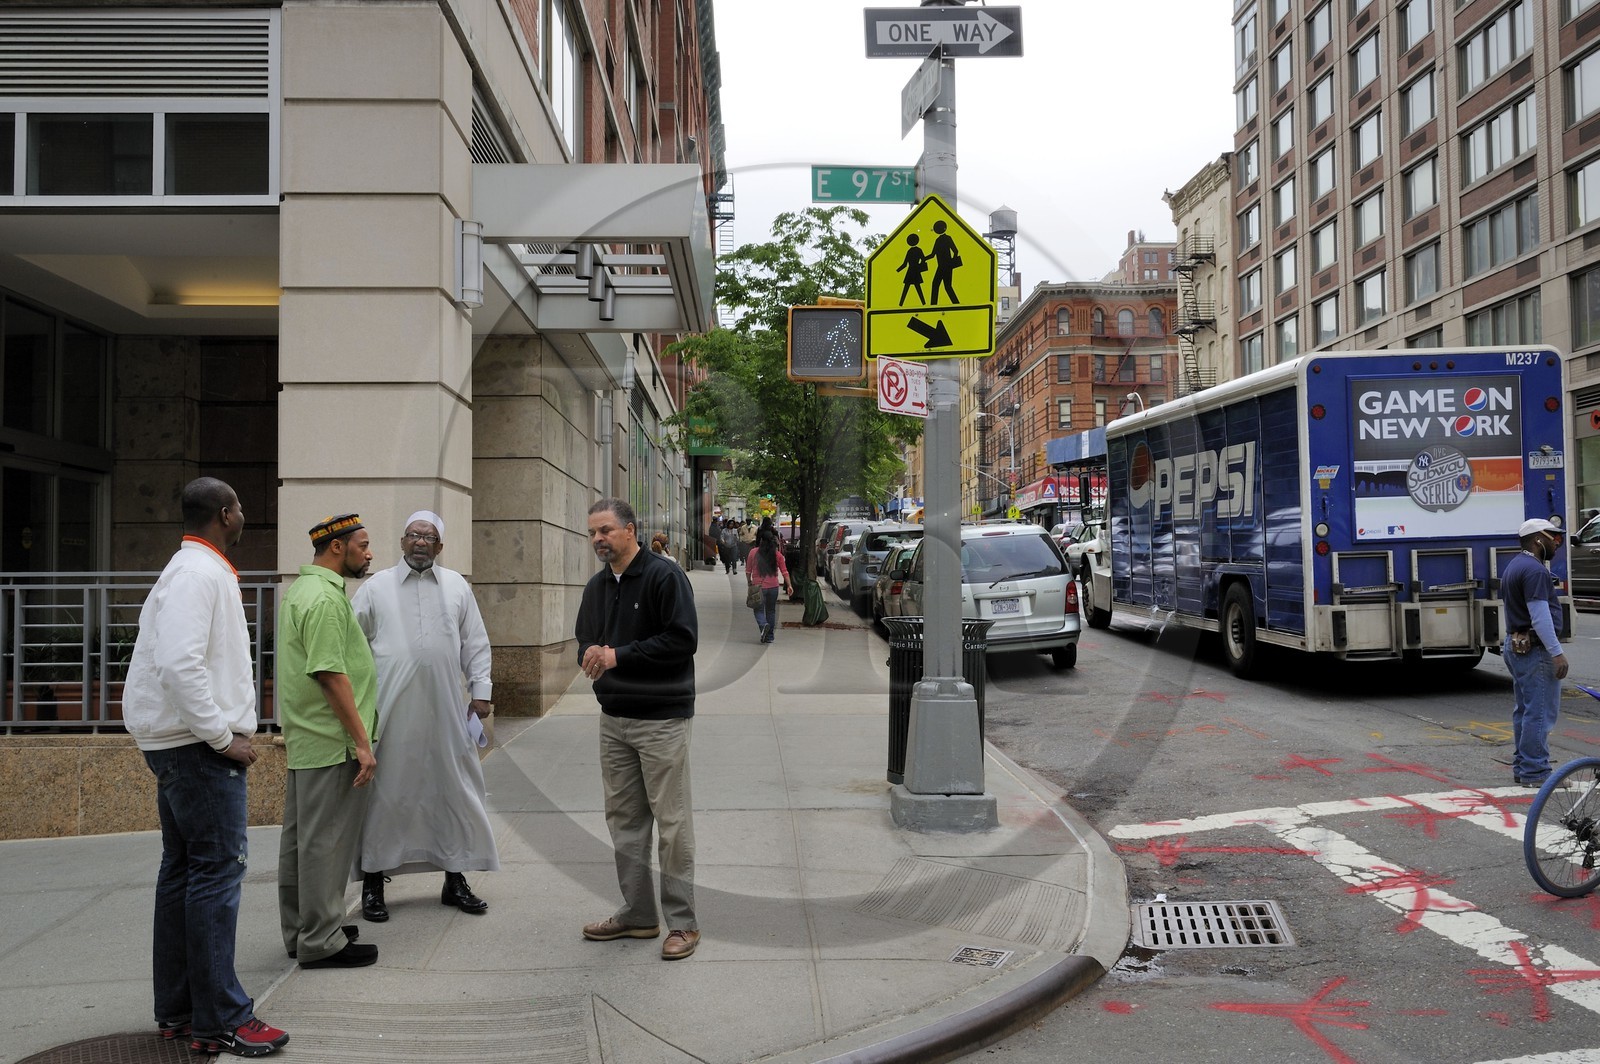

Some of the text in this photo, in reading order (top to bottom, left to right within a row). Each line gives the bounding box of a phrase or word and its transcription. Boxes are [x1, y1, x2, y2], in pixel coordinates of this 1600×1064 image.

[888, 23, 998, 43] ONE WAY
[817, 169, 912, 199] E 97 ST
[1505, 352, 1541, 366] M237
[1358, 386, 1513, 415] GAME ON
[1358, 414, 1513, 440] NEW YORK
[1432, 447, 1447, 457] NYC
[1153, 440, 1257, 521] PEPSI
[1408, 456, 1465, 489] Subway
[1422, 479, 1458, 505] SERIES
